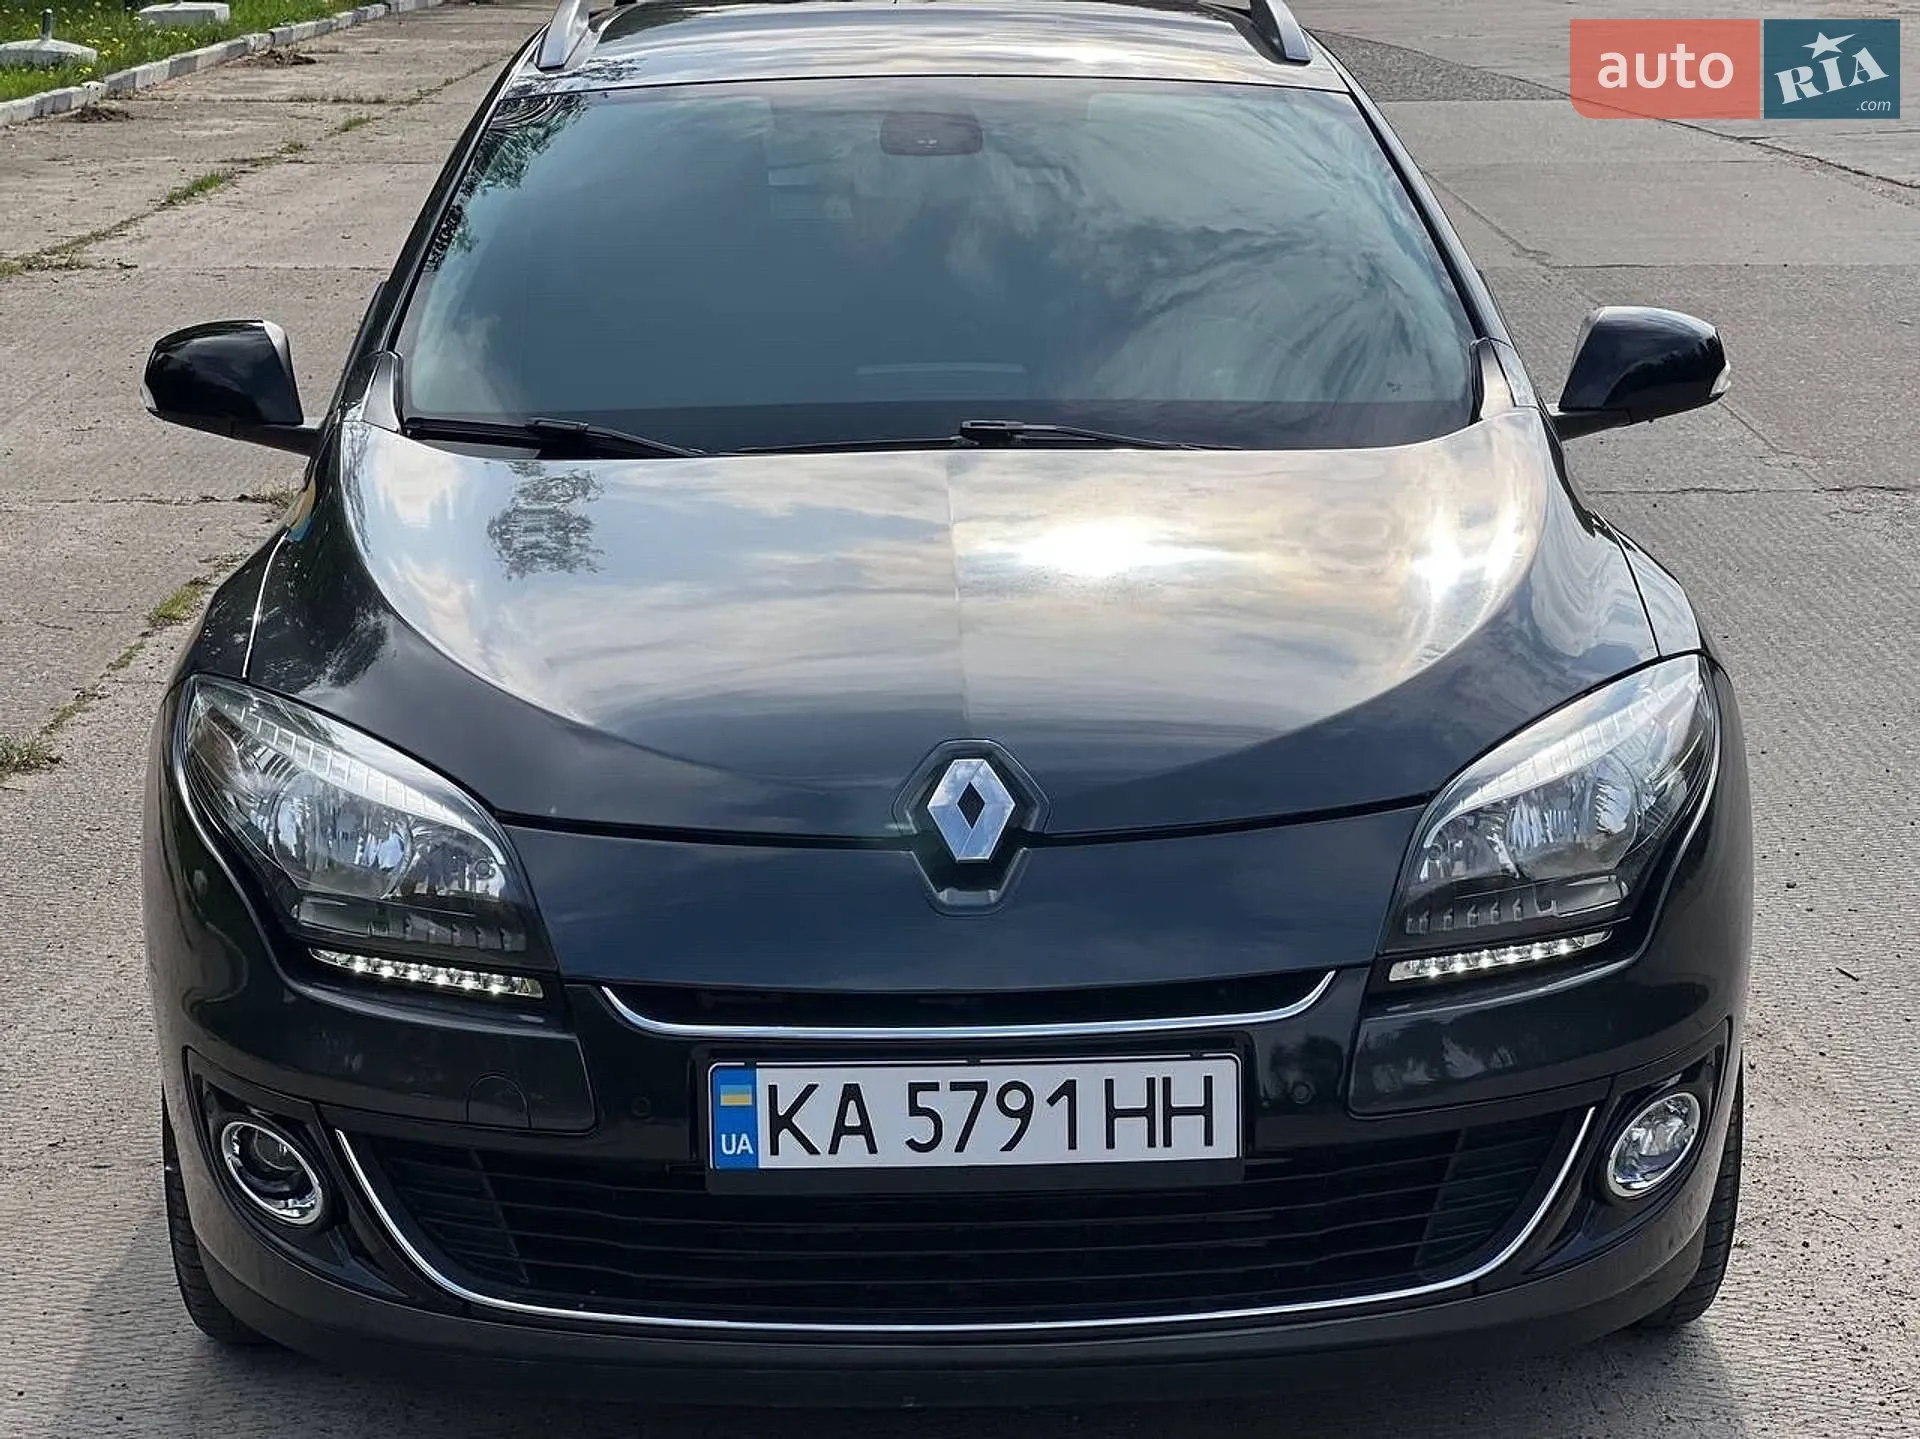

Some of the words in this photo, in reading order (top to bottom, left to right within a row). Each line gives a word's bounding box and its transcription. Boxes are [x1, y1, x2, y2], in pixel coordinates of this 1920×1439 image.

[767, 1083, 878, 1156] KA
[905, 1079, 1078, 1153] 5791
[1103, 1075, 1214, 1150] HH
[721, 1134, 754, 1156] UA
